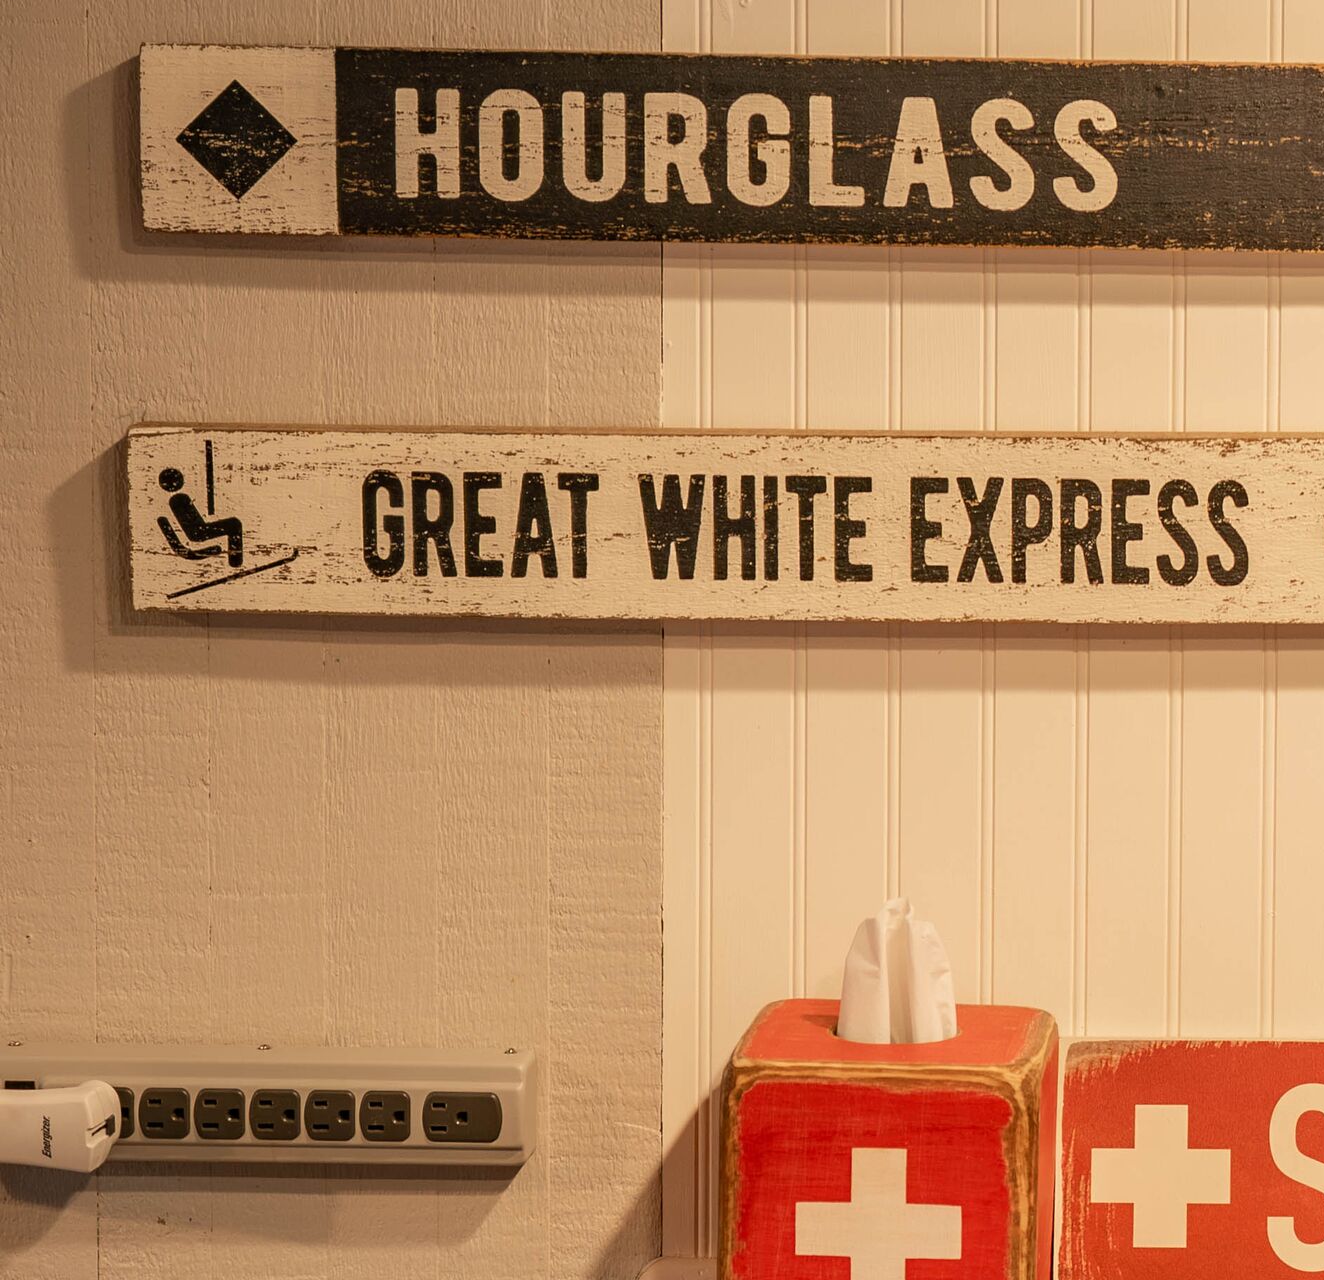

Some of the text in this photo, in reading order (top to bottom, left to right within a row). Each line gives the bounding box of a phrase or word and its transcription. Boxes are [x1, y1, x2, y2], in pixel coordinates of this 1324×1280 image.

[394, 87, 1119, 212] HOURGLASS
[361, 468, 1250, 588] GREAT WHITE EXPRESS
[41, 1115, 53, 1158] Energizer
